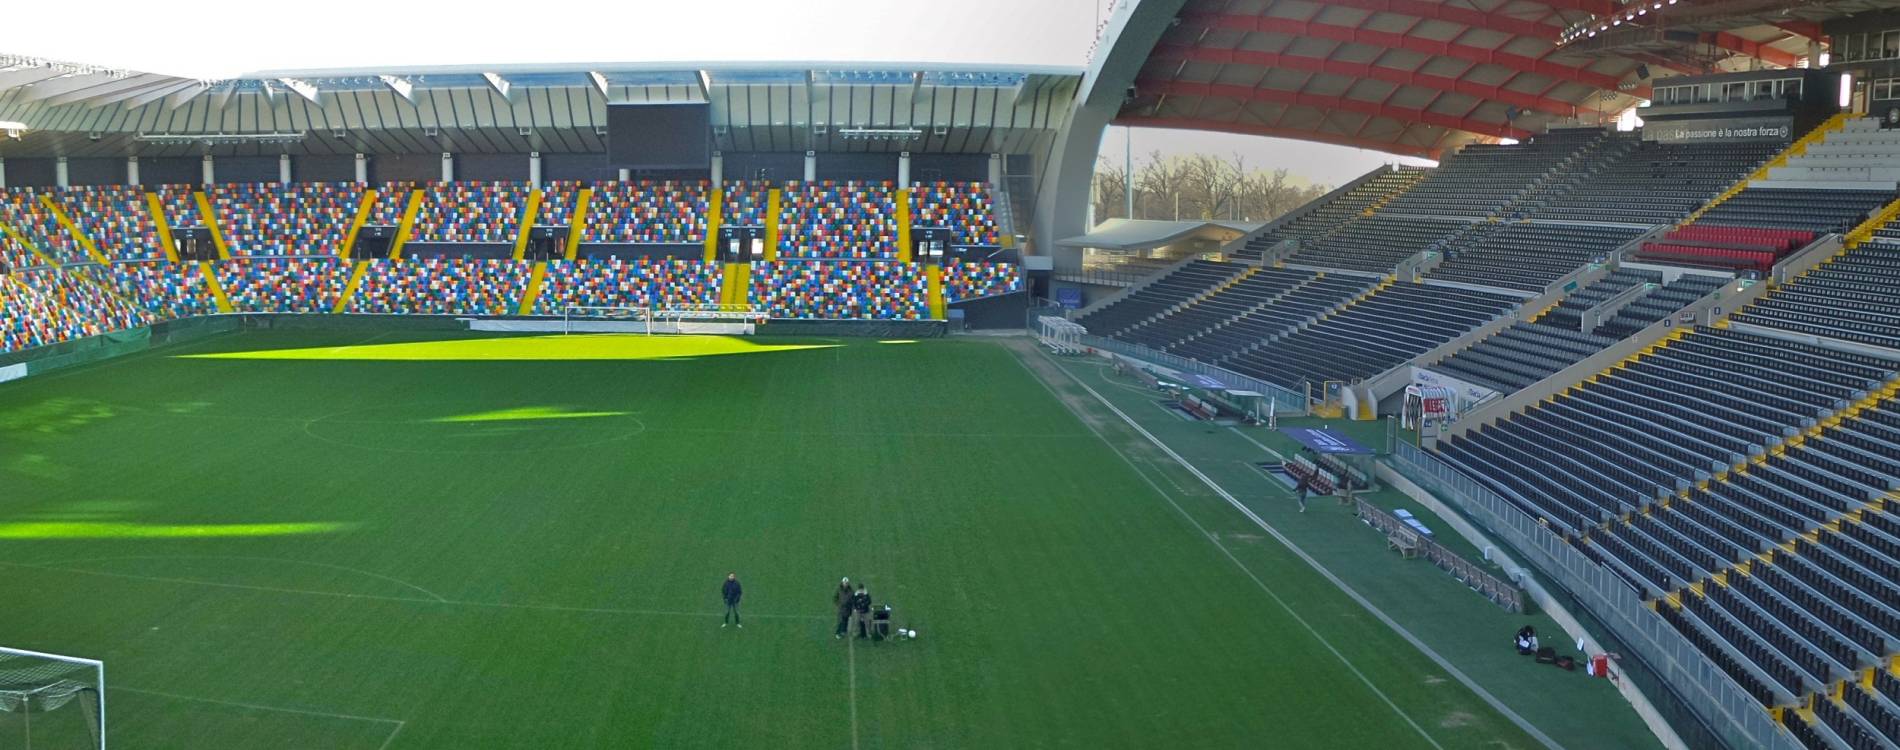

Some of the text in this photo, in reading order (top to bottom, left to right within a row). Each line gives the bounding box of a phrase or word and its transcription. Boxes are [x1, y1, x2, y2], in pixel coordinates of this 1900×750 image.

[1676, 128, 1684, 138] La
[1686, 130, 1716, 140] passione
[1718, 128, 1723, 137] è
[1726, 128, 1731, 136] la
[1734, 128, 1757, 136] nostra
[1759, 126, 1778, 136] forza
